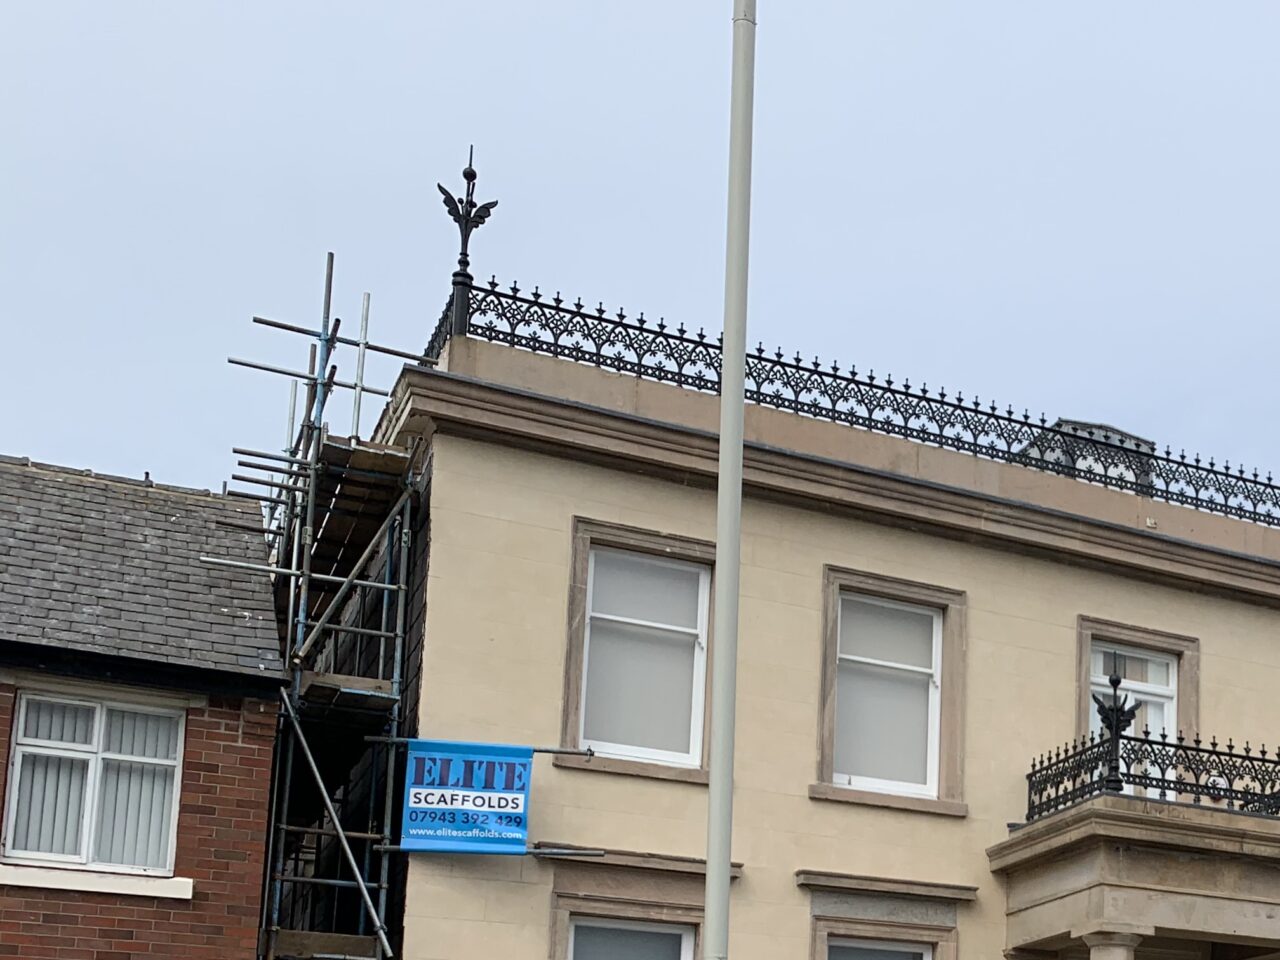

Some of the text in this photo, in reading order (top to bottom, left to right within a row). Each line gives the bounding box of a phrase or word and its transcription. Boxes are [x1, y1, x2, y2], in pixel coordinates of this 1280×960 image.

[411, 756, 528, 791] ELITE
[412, 792, 520, 810] SCAFFOLDS
[409, 811, 523, 827] 07943 392 429
[408, 827, 523, 839] www.elitescaffolds.com
